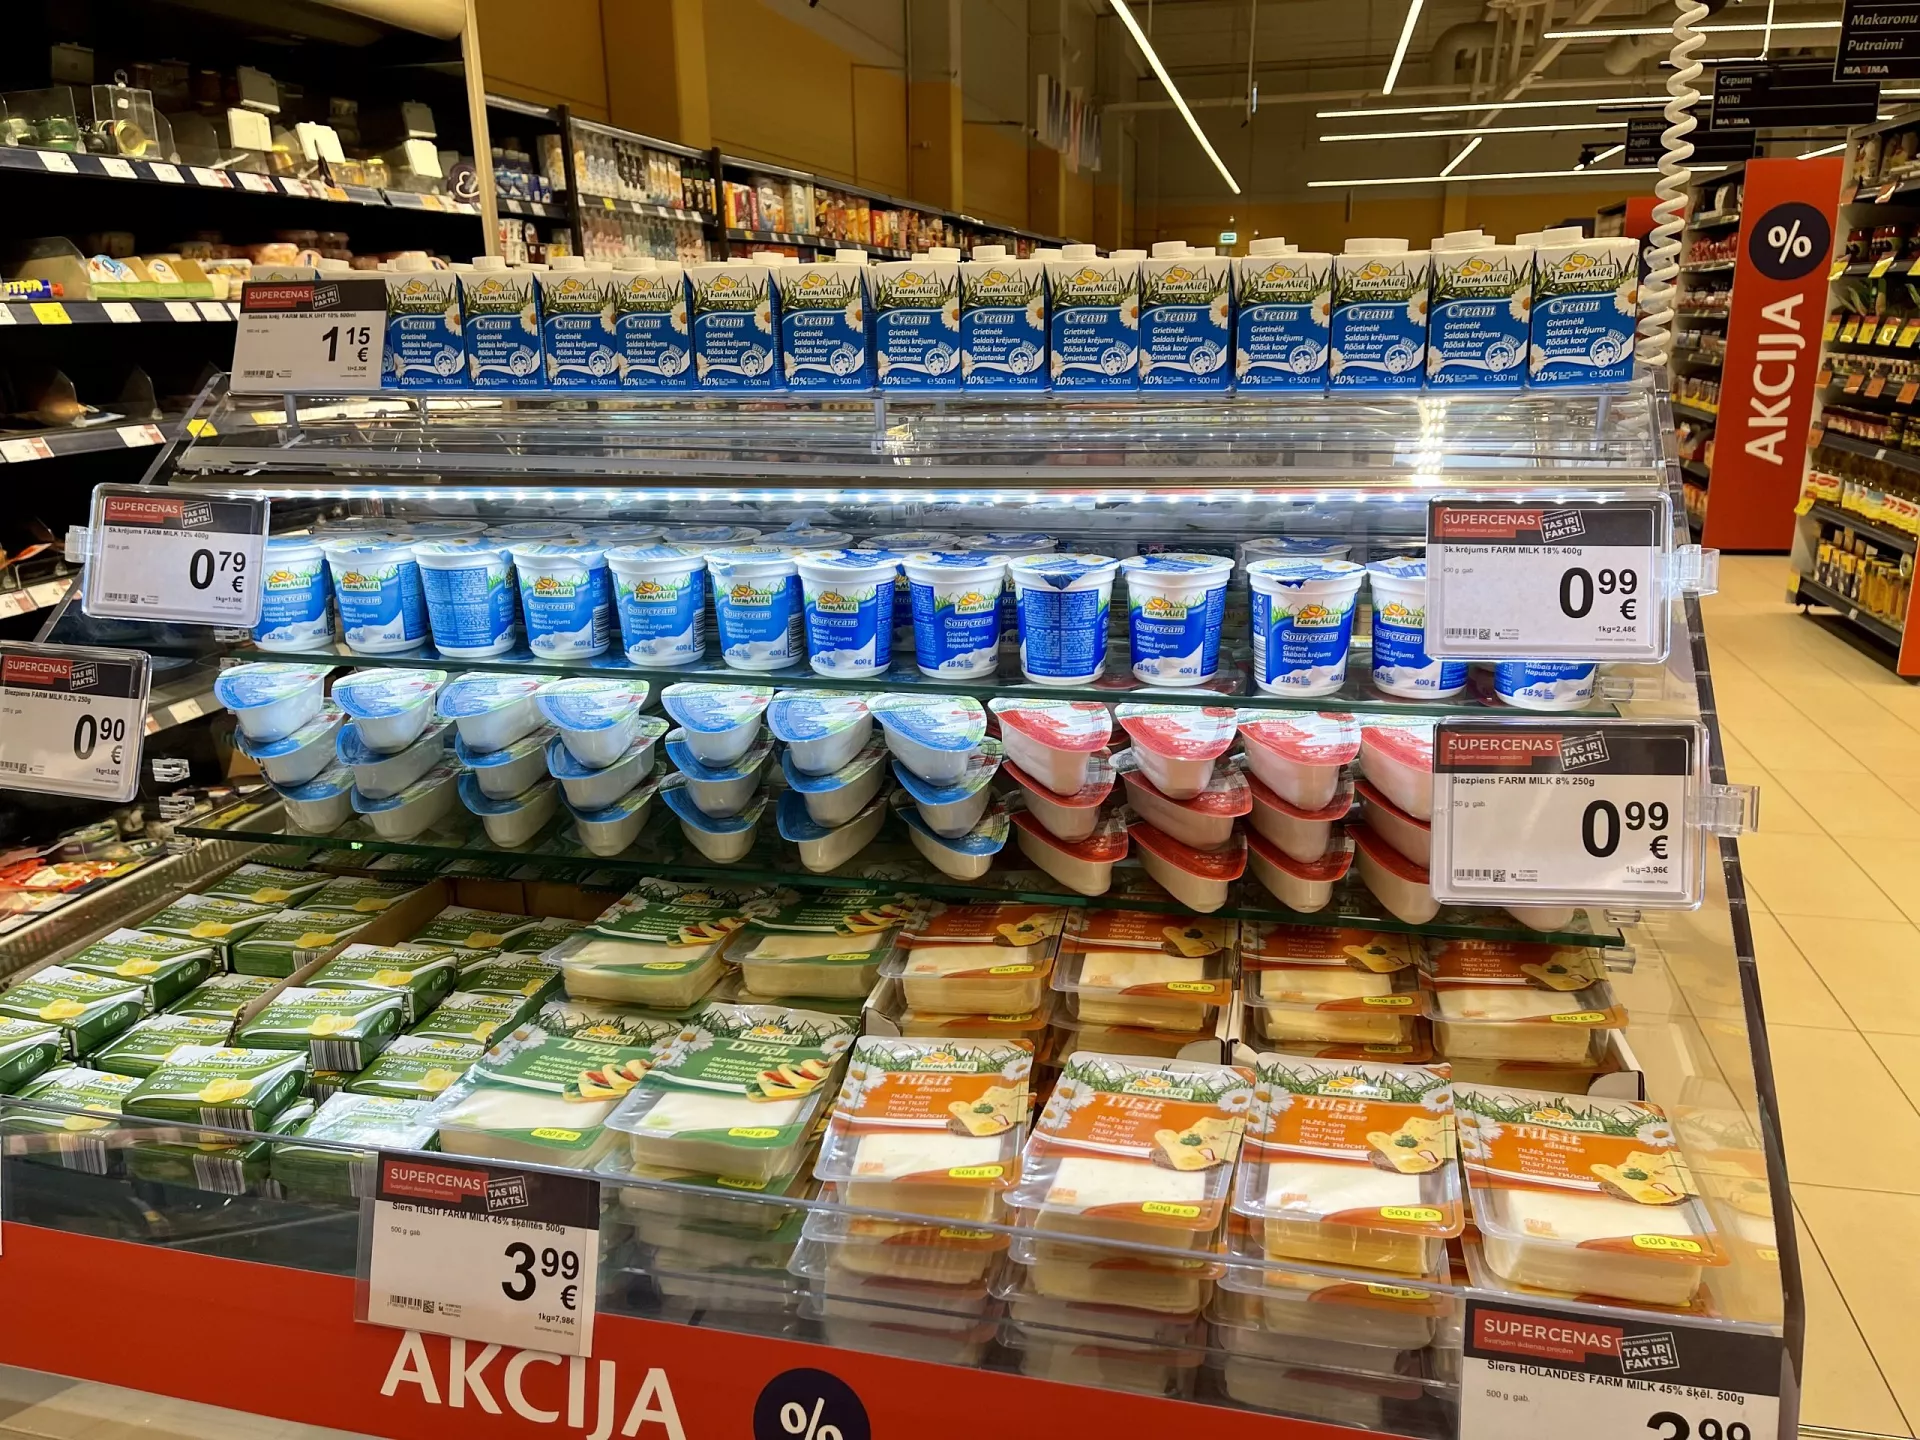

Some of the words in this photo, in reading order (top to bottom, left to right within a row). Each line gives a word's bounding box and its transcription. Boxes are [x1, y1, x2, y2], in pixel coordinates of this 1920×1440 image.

[1851, 13, 1918, 25] Makaronu
[1847, 37, 1904, 51] Putraimi
[1843, 65, 1889, 74] MAXIMA
[250, 290, 309, 300] SUPERCENAS
[1447, 304, 1497, 317] Cream
[1548, 300, 1600, 315] Cream
[1546, 328, 1573, 337] Saldais
[322, 326, 338, 362] 1
[346, 327, 370, 345] 15
[1570, 337, 1588, 345] koor
[357, 347, 369, 362] €
[1535, 371, 1557, 381] 10%
[1598, 369, 1614, 378] 500
[1745, 293, 1806, 466] AKCIJA
[110, 501, 178, 514] SUPERCENAS
[183, 510, 198, 519] TAS
[1443, 514, 1536, 526] SUPERCENAS
[1543, 520, 1563, 530] TAS
[1518, 547, 1540, 555] MILK
[1542, 547, 1560, 555] 18%
[1561, 547, 1582, 556] 400g
[189, 549, 215, 590] 0
[219, 551, 246, 572] 79
[232, 576, 244, 593] €
[1559, 567, 1594, 618] 0
[1598, 568, 1638, 595] 99
[1619, 598, 1637, 620] €
[7, 661, 68, 674] SUPERCENAS
[4, 689, 30, 697] Biezpiens
[31, 691, 48, 699] FARM
[74, 714, 97, 760] 0
[100, 717, 125, 742] 90
[1449, 739, 1553, 751] SUPERCENAS
[1563, 745, 1585, 757] TAS
[111, 745, 122, 765] €
[1452, 776, 1496, 786] Biezpiens
[1498, 776, 1527, 785] FARM
[1529, 776, 1553, 785] MILK
[1555, 777, 1570, 785] 8%
[1572, 777, 1595, 788] 250g
[1582, 799, 1621, 858] 0
[1624, 802, 1669, 831] 99
[1649, 835, 1668, 860] €
[726, 1041, 790, 1057] Dutch
[895, 1074, 954, 1087] Tilsit
[1302, 1098, 1368, 1114] Tilsit
[1513, 1126, 1582, 1146] Tilsit
[1544, 1142, 1586, 1154] cheese
[391, 1168, 481, 1190] SUPERCENAS
[488, 1187, 507, 1198] TAS
[392, 1201, 413, 1212] Siers
[415, 1205, 440, 1216] TILSIT
[442, 1208, 467, 1220] FARM
[469, 1212, 490, 1223] MILK
[492, 1216, 509, 1226] 45%
[545, 1223, 565, 1235] 500g
[1640, 1237, 1667, 1246] 500
[501, 1241, 537, 1301] 3
[541, 1247, 579, 1280] 99
[560, 1284, 578, 1311] €
[1484, 1319, 1612, 1348] SUPERCENAS
[1623, 1346, 1649, 1358] TAS
[380, 1330, 687, 1440] AKCIJA
[1487, 1359, 1516, 1373] Siers
[1519, 1364, 1586, 1382] HOLANDES
[1589, 1374, 1623, 1388] FARM
[1626, 1380, 1655, 1392] MILK
[1658, 1384, 1683, 1396] 45%
[1717, 1391, 1744, 1405] 500g
[1486, 1389, 1501, 1398] 500
